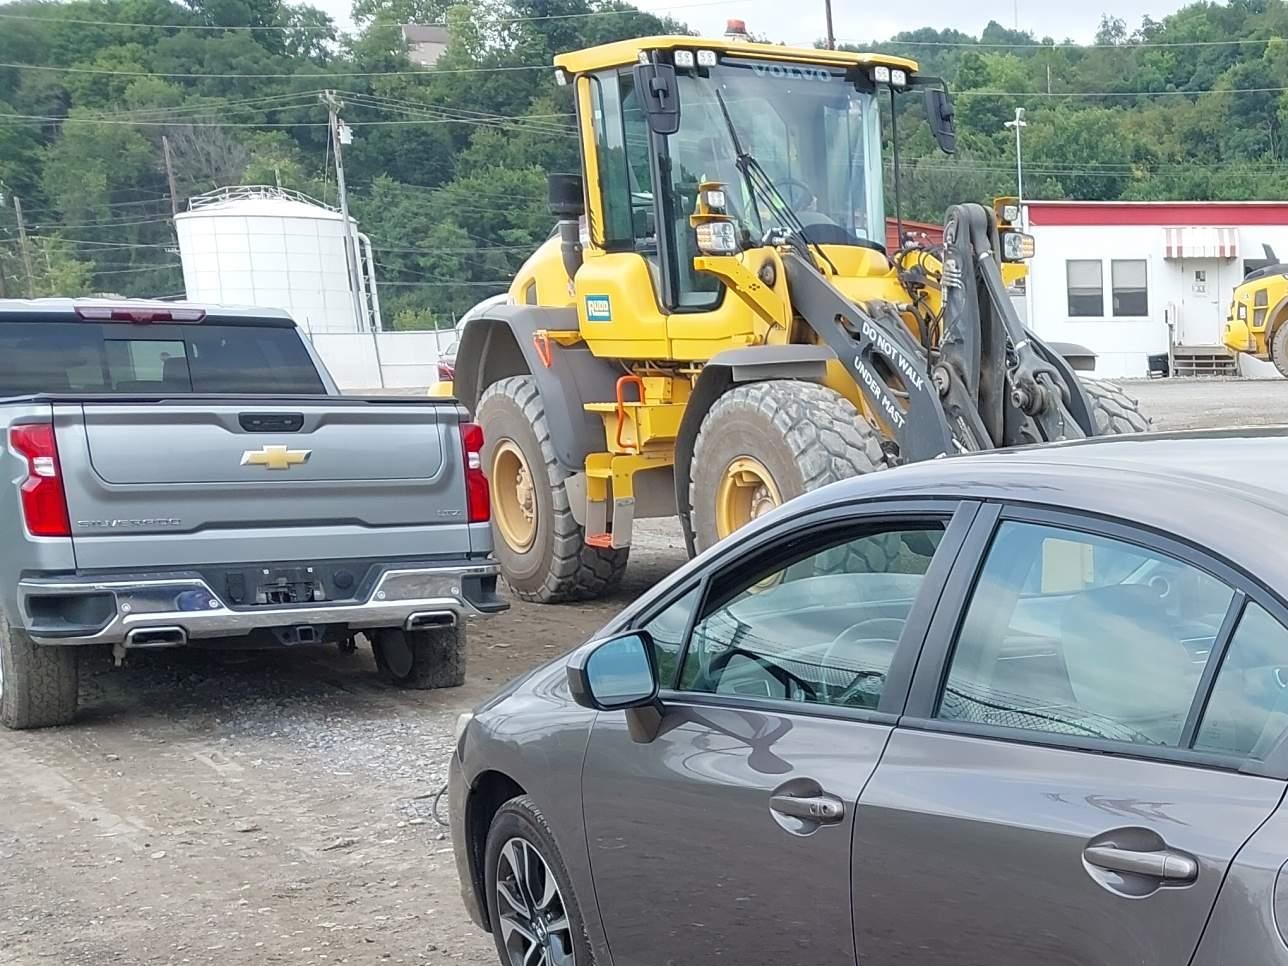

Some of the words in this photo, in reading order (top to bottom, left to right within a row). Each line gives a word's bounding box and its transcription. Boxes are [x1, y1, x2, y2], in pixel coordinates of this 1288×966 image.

[752, 64, 832, 81] VOLVO
[862, 322, 876, 340] DO
[877, 339, 898, 359] NOT
[898, 354, 924, 391] WALK
[854, 356, 881, 399] UNDER
[881, 395, 906, 428] MAST
[77, 518, 181, 527] SILVERADO
